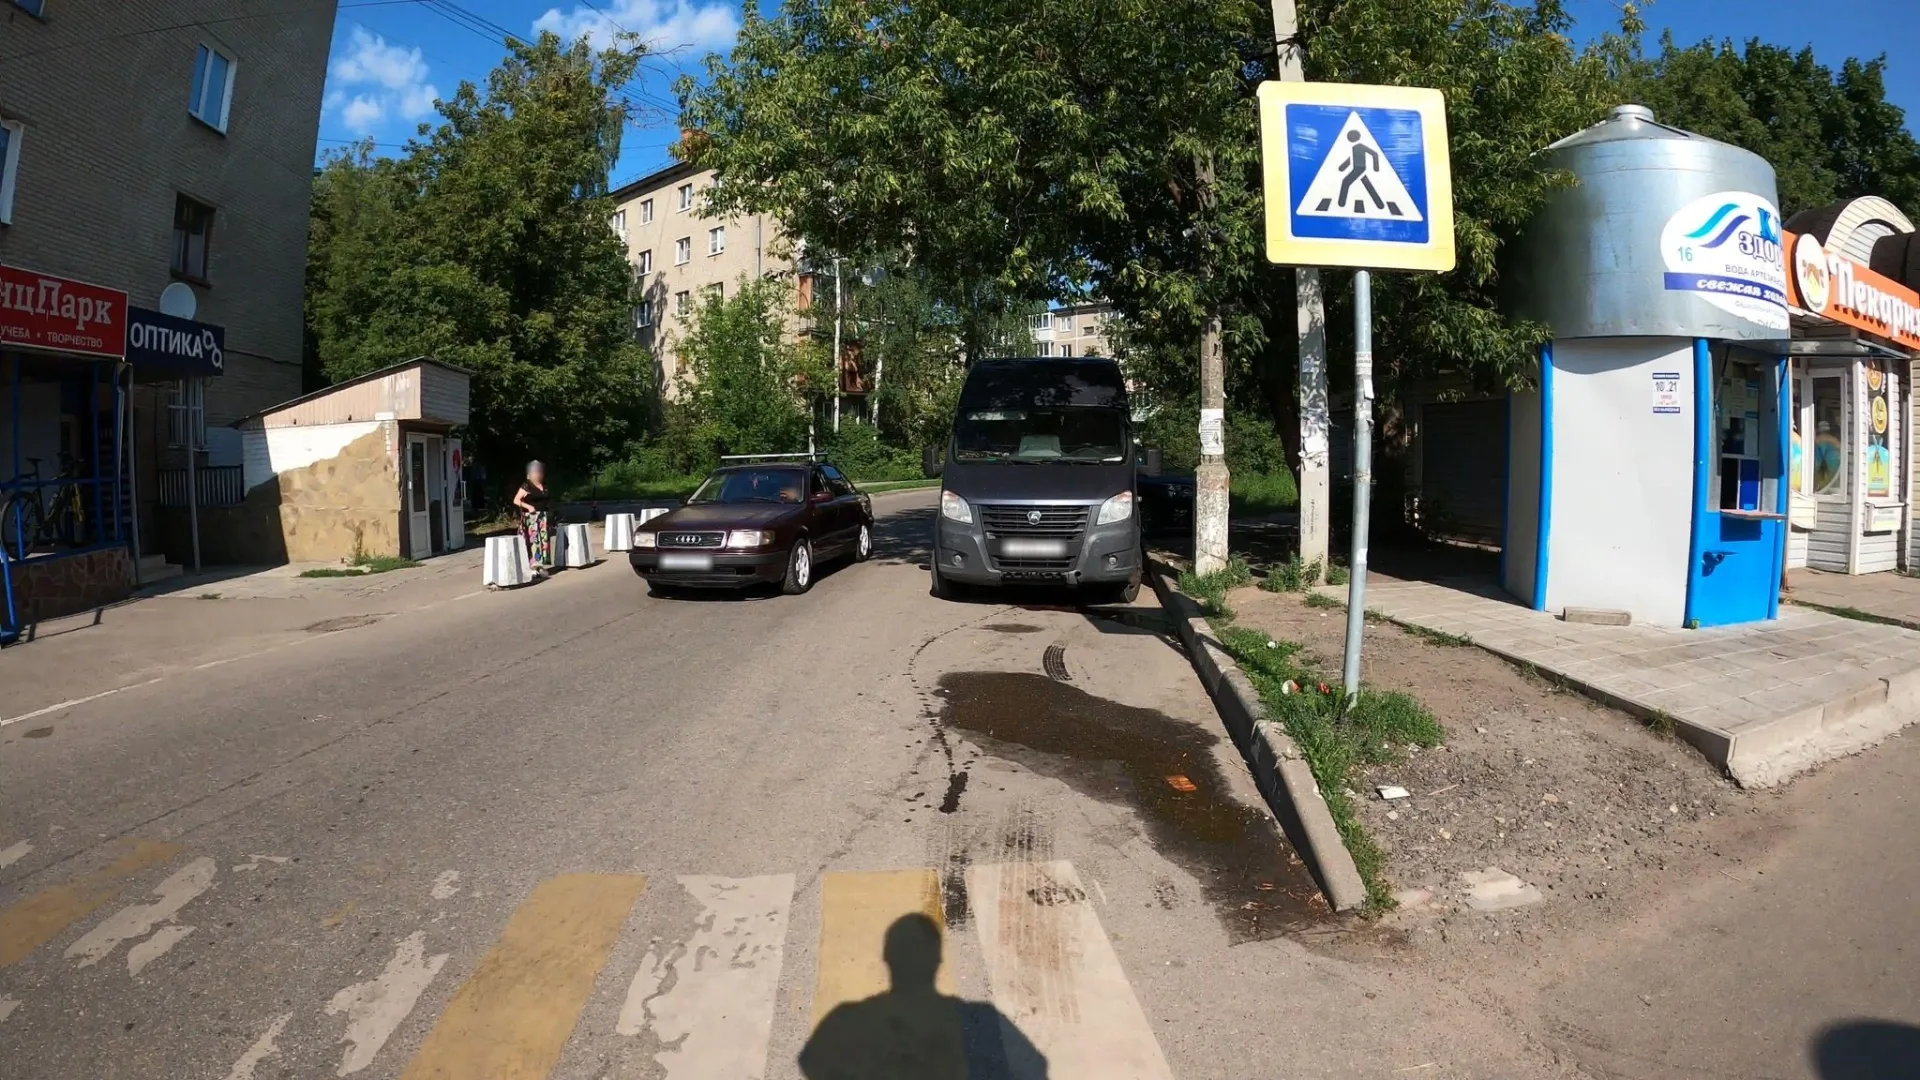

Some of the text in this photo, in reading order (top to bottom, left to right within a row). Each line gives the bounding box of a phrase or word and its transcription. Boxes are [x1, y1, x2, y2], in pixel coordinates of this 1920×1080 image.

[1678, 246, 1693, 262] 16
[1725, 264, 1748, 275] ВОДА
[0, 324, 103, 349] УЧЕБА ТВОРЧЕСТВО
[130, 322, 204, 359] ОПТИКА
